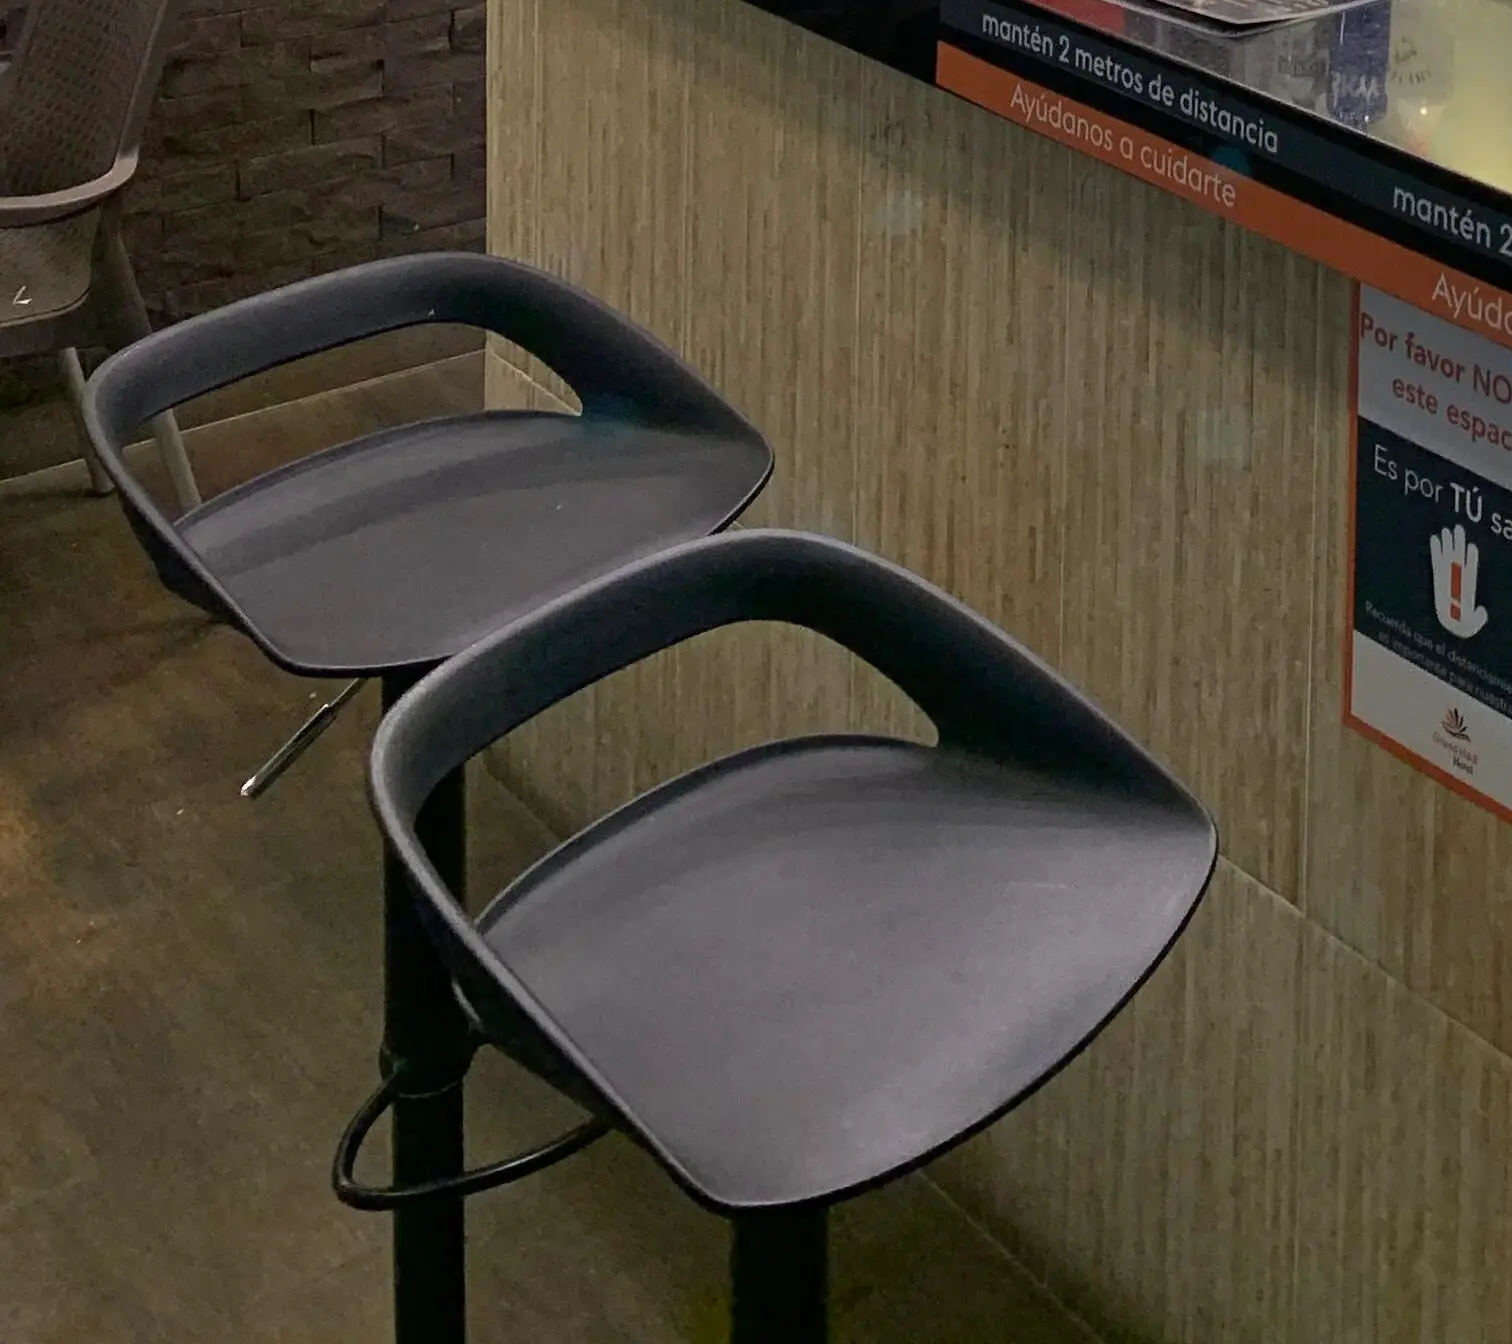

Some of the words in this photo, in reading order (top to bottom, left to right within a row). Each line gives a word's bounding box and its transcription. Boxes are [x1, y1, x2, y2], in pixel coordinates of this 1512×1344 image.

[982, 12, 1054, 58] mantén
[1058, 33, 1071, 64] 2
[1075, 45, 1144, 95] metros
[1148, 73, 1175, 108] de
[1179, 88, 1279, 155] distancia
[1010, 83, 1114, 153] Ayúdanos
[1119, 133, 1134, 163] a
[1139, 144, 1237, 209] cuidarte
[1392, 185, 1491, 249] mantén
[1359, 311, 1398, 354] Por
[1404, 331, 1466, 382] favor
[1391, 376, 1440, 416] este
[1373, 443, 1398, 482] Es
[1404, 467, 1443, 504] por
[1449, 481, 1484, 525] TÚ
